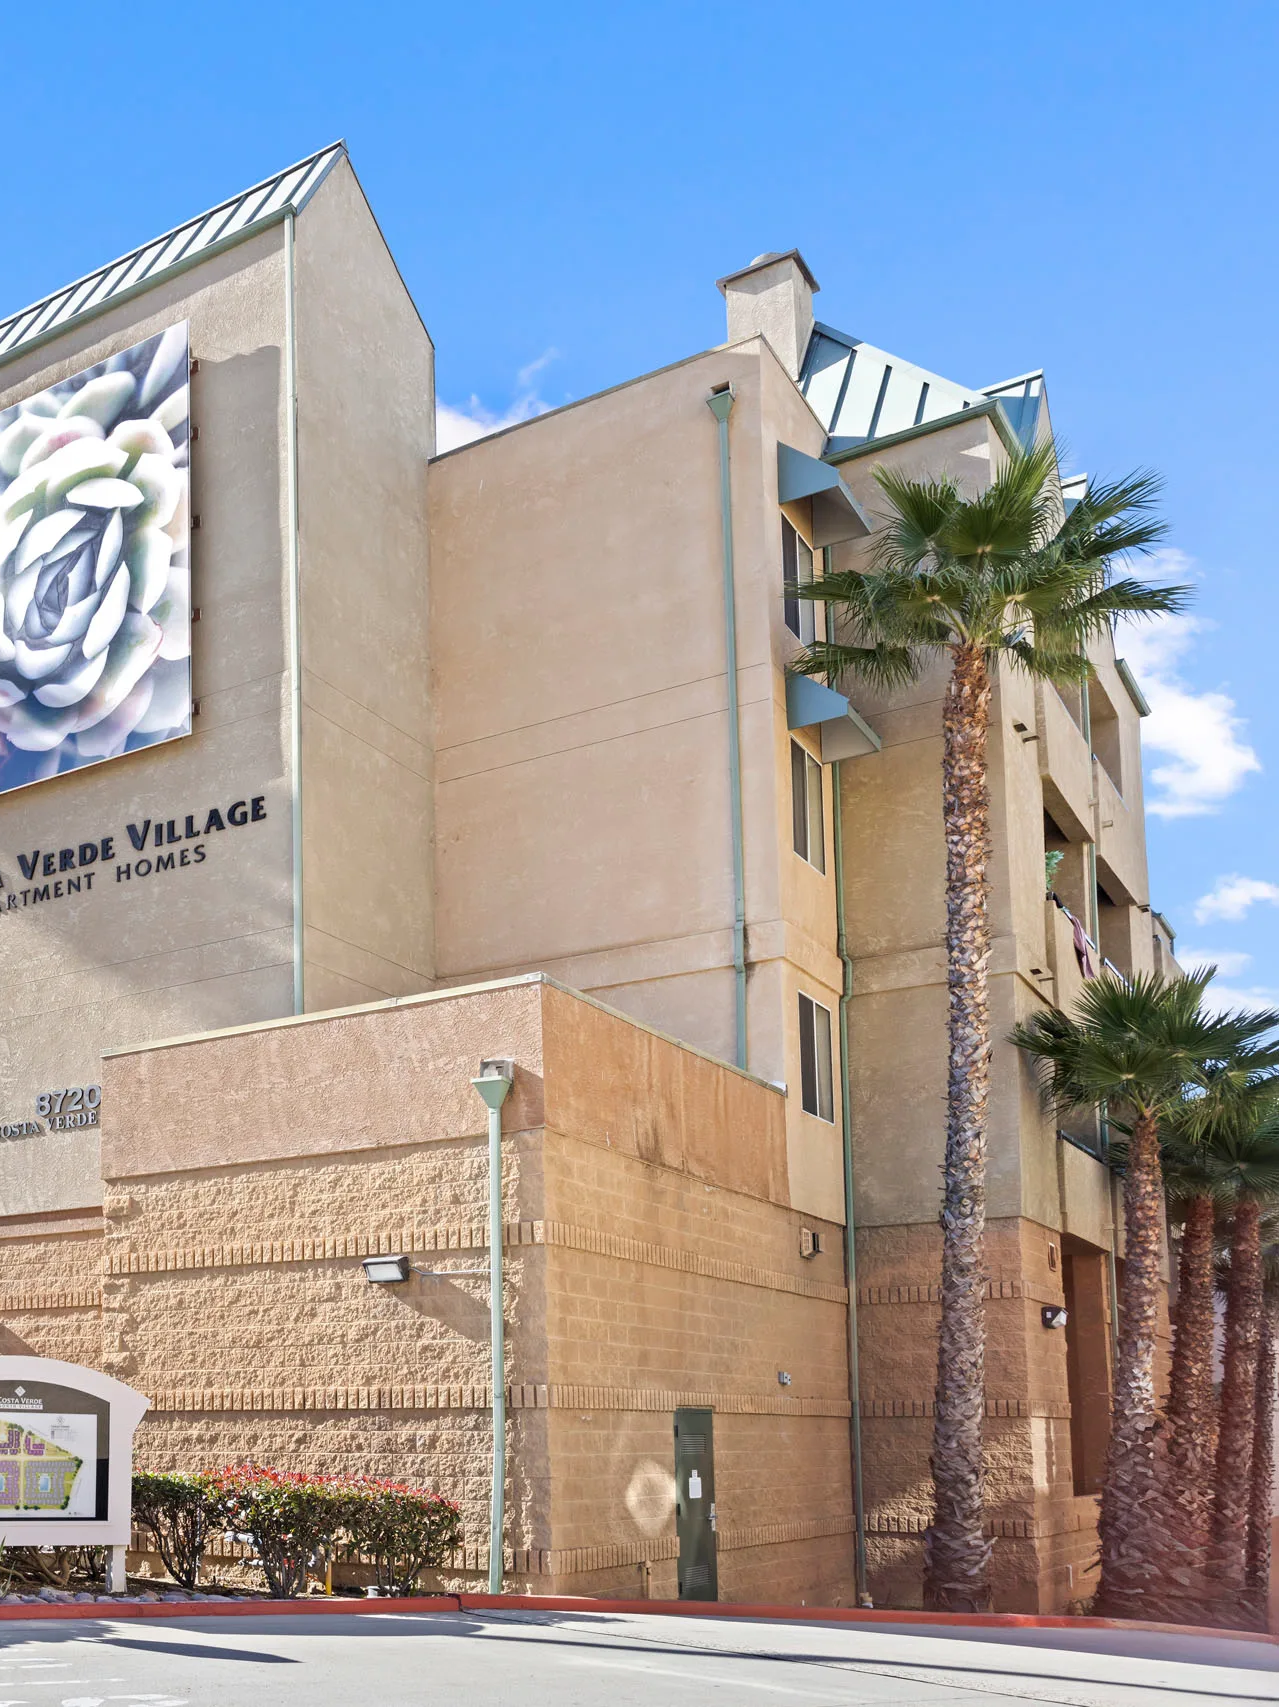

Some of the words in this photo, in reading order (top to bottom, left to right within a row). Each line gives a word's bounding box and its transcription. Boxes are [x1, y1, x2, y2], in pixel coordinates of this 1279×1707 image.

[17, 837, 116, 880] VERDE
[126, 796, 267, 851] VILLAGE
[116, 844, 207, 883] HOMES
[35, 1084, 102, 1117] 8720
[46, 1111, 99, 1131] VERDE
[20, 1397, 43, 1405] VERDE
